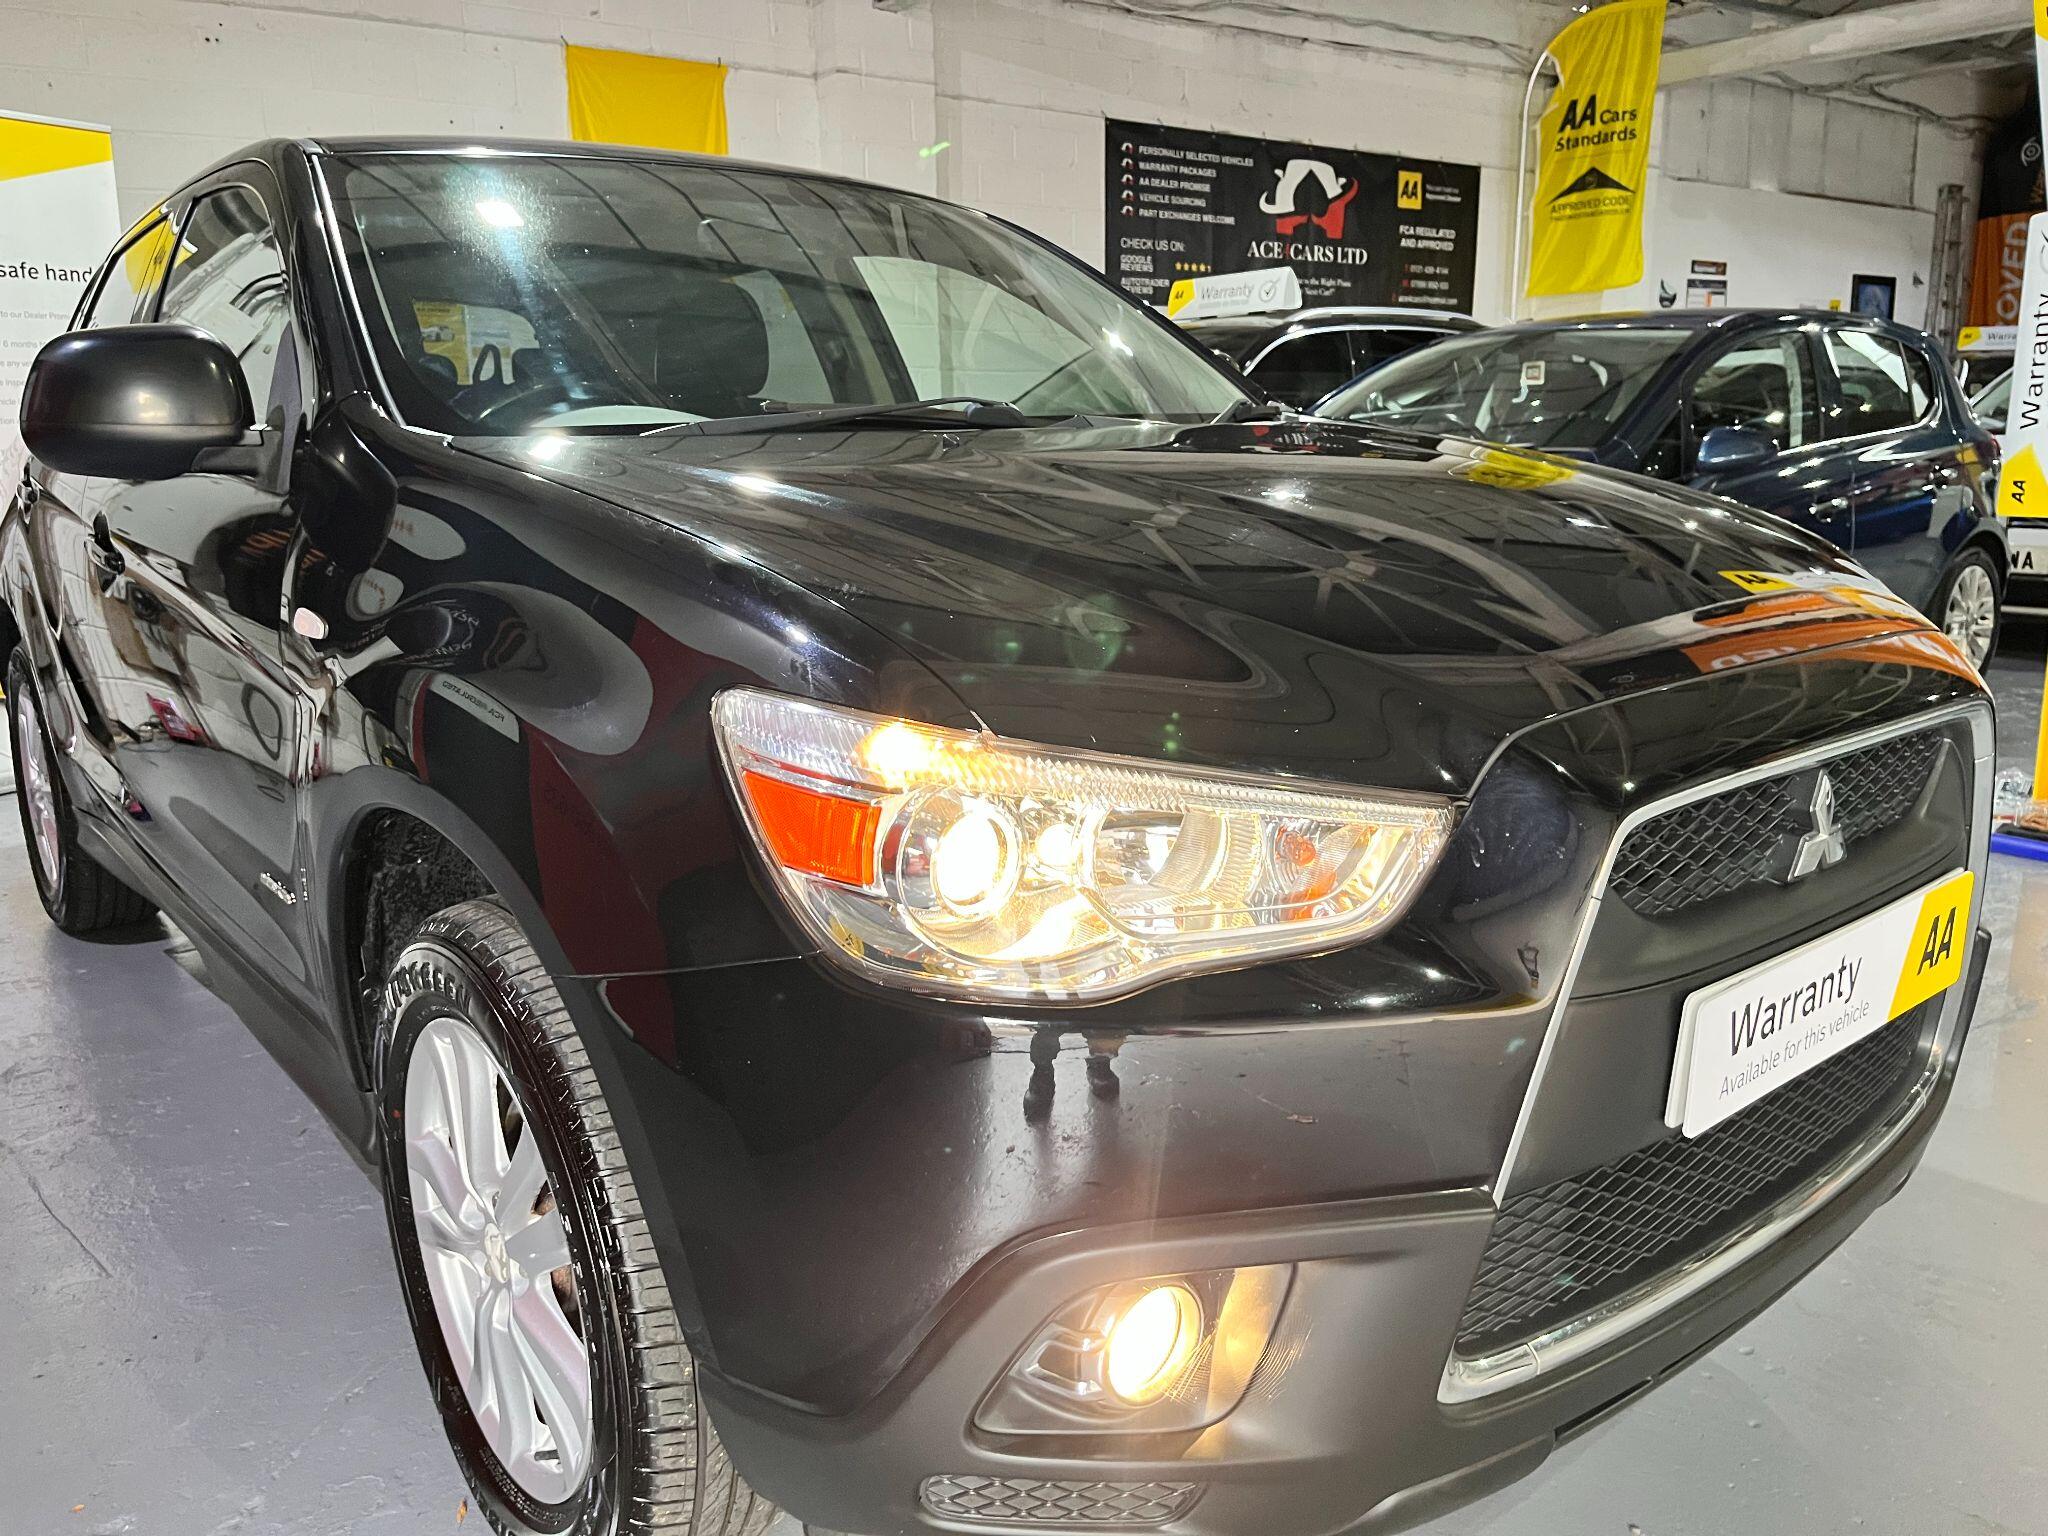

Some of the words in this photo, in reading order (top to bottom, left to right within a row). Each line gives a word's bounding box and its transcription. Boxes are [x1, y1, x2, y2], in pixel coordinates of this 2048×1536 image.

[1558, 94, 1596, 133] AA
[1600, 109, 1638, 125] Cars
[1555, 127, 1637, 152] Standards
[1139, 145, 1185, 159] PERSONALLY
[1139, 161, 1179, 173] WARRANTY
[1179, 165, 1217, 178] PACKAGES
[1151, 178, 1179, 189] DEALER
[1401, 180, 1418, 200] AA
[1139, 193, 1170, 204] VEHICLE
[1139, 208, 1158, 218] PART
[1120, 238, 1153, 250] CHECK
[1155, 240, 1168, 251] US
[1247, 240, 1283, 258] ACE
[1290, 243, 1334, 263] CARS
[1337, 247, 1368, 265] LTD
[1120, 254, 1152, 263] GOOGLE
[0, 262, 39, 280] safe
[1201, 280, 1254, 300] Warranty
[2012, 480, 2026, 503] AA
[1916, 906, 1957, 976] AA
[1730, 955, 1862, 1057] Warranty
[1718, 1048, 1780, 1101] Available
[1782, 1036, 1802, 1064] for
[1803, 1023, 1826, 1052] this
[1829, 999, 1870, 1036] vehicle
